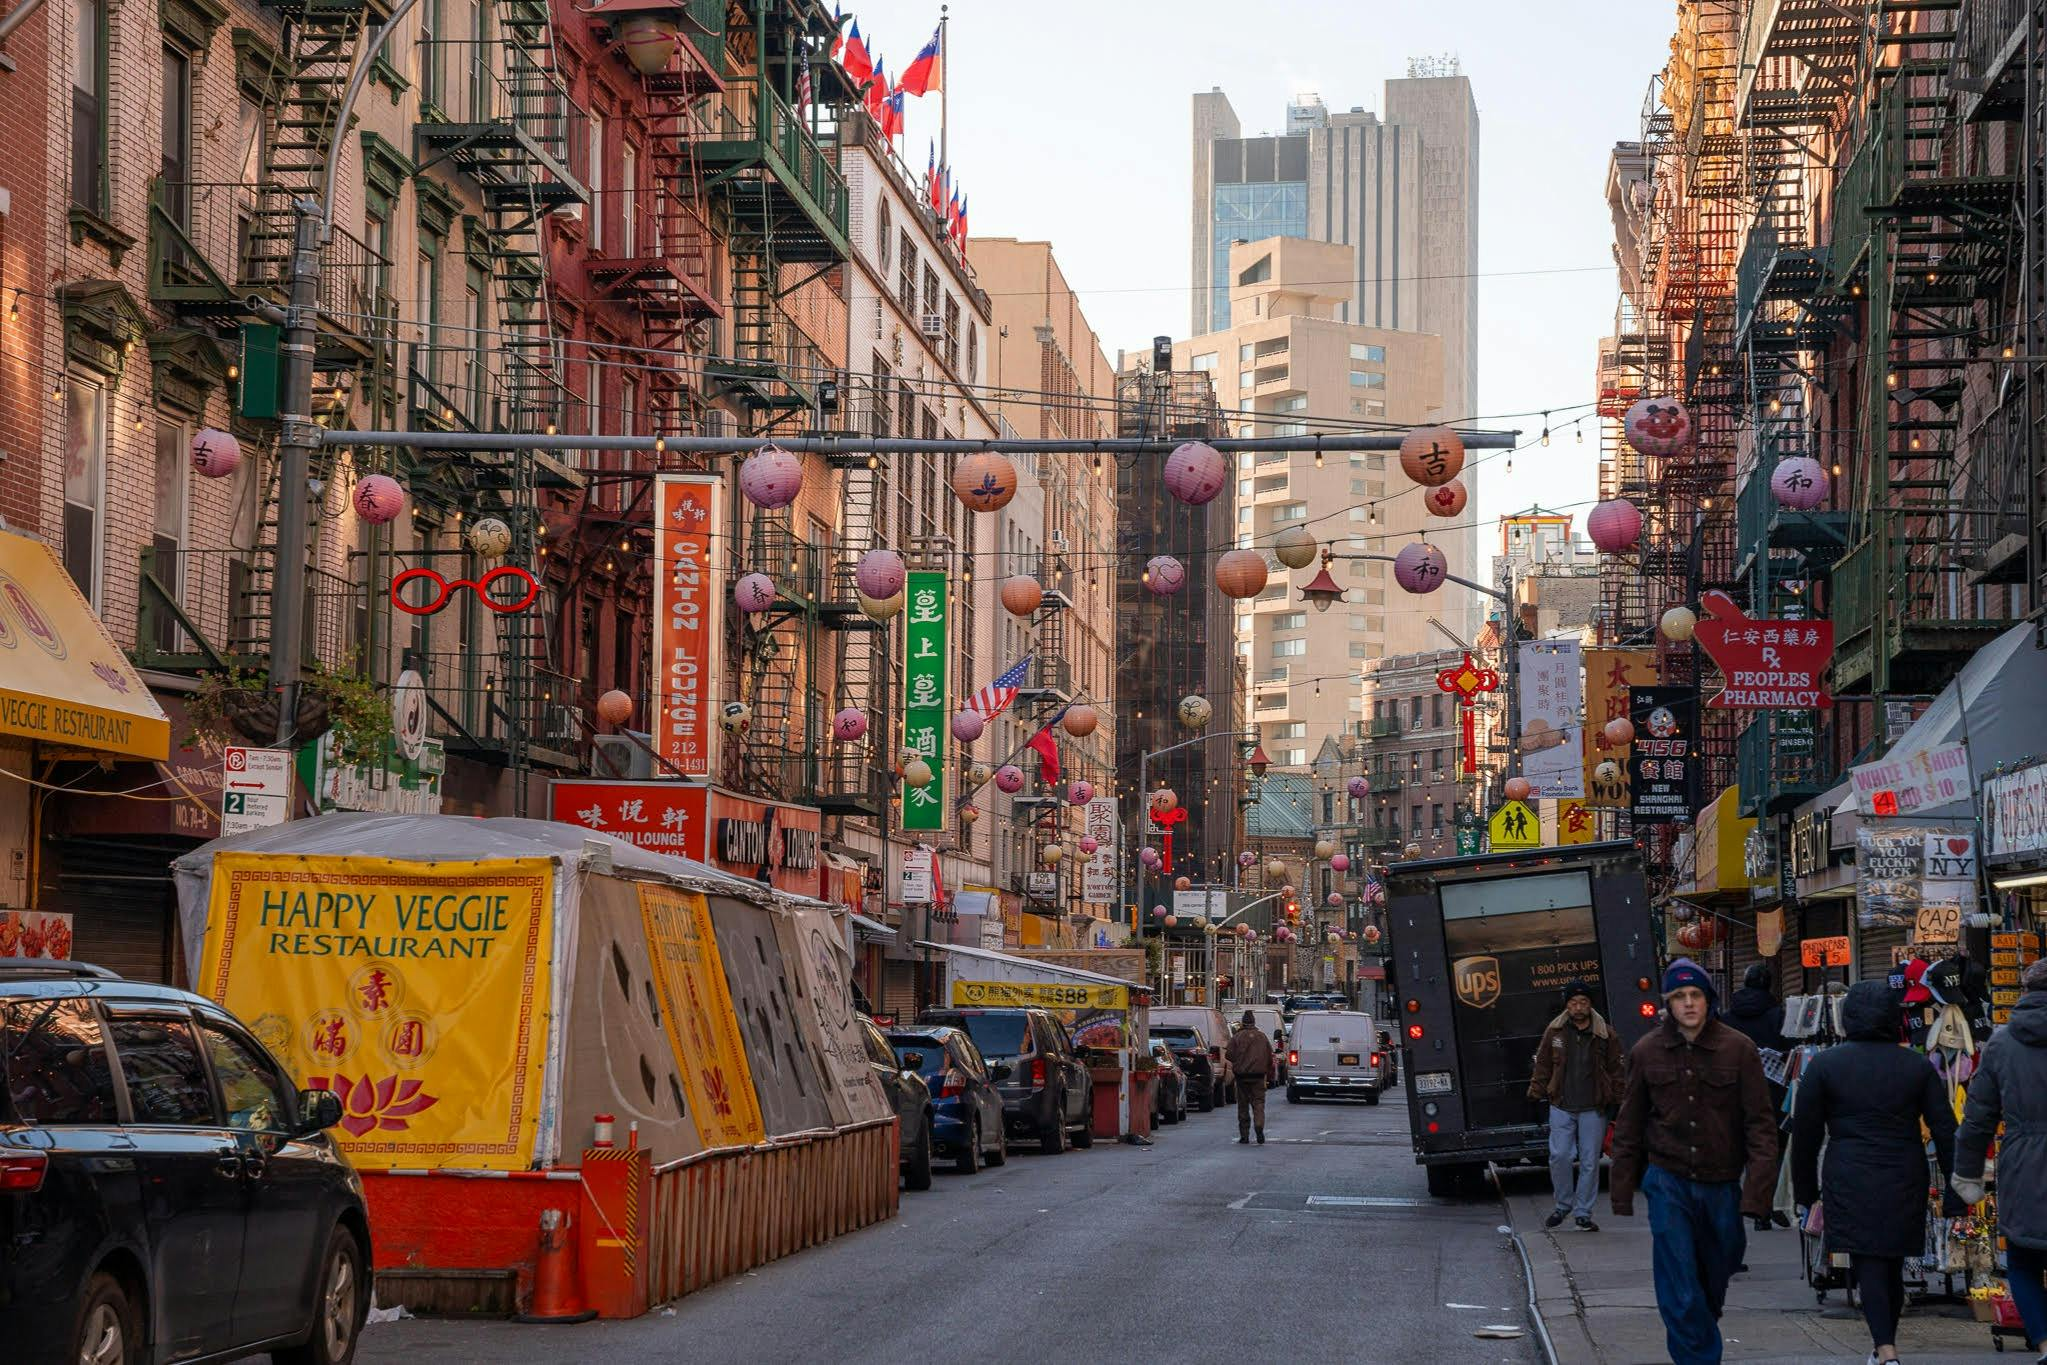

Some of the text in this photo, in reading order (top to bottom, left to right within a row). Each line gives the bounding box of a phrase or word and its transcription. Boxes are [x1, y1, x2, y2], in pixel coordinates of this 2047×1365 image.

[194, 441, 212, 467] 吉
[1420, 442, 1449, 477] 吉
[1784, 469, 1813, 493] 和
[358, 483, 378, 511] 春
[1413, 557, 1439, 580] 和
[751, 582, 769, 604] 春
[671, 542, 699, 736] CANTON LOUNGE
[1722, 628, 1820, 646] 仁安西藥房
[1733, 672, 1810, 687] PEOPLES
[1723, 691, 1820, 706] PHARMACY
[1, 697, 131, 745] VEGGIE RESTAURANT
[840, 719, 857, 733] 和
[672, 742, 697, 754] 212
[1637, 740, 1687, 757] 456
[1006, 771, 1019, 783] 和
[1640, 760, 1684, 780] 餐館
[1856, 764, 1904, 791] WHITE
[1075, 787, 1086, 800] 吉
[1652, 784, 1670, 792] NEW
[229, 794, 240, 813] 2
[1640, 795, 1682, 803] SHANGHAI
[1876, 792, 1893, 808] 4
[1634, 806, 1689, 814] RESTAURANT
[637, 831, 685, 846] LOUNGE
[727, 818, 765, 864] CANTON
[1933, 838, 1945, 855] I
[1879, 847, 1907, 858] YOU
[1874, 867, 1913, 879] FUCK
[1929, 858, 1973, 875] NY
[260, 890, 509, 932] HAPPY VEGGIE
[1918, 909, 1958, 931] CAP
[268, 933, 495, 959] RESTAURANT
[1536, 963, 1555, 975] 800
[1557, 961, 1580, 973] PICK
[1580, 960, 1600, 971] UPS
[357, 970, 392, 1012] 素
[1457, 969, 1497, 1000] ups
[1055, 988, 1088, 1004] $88
